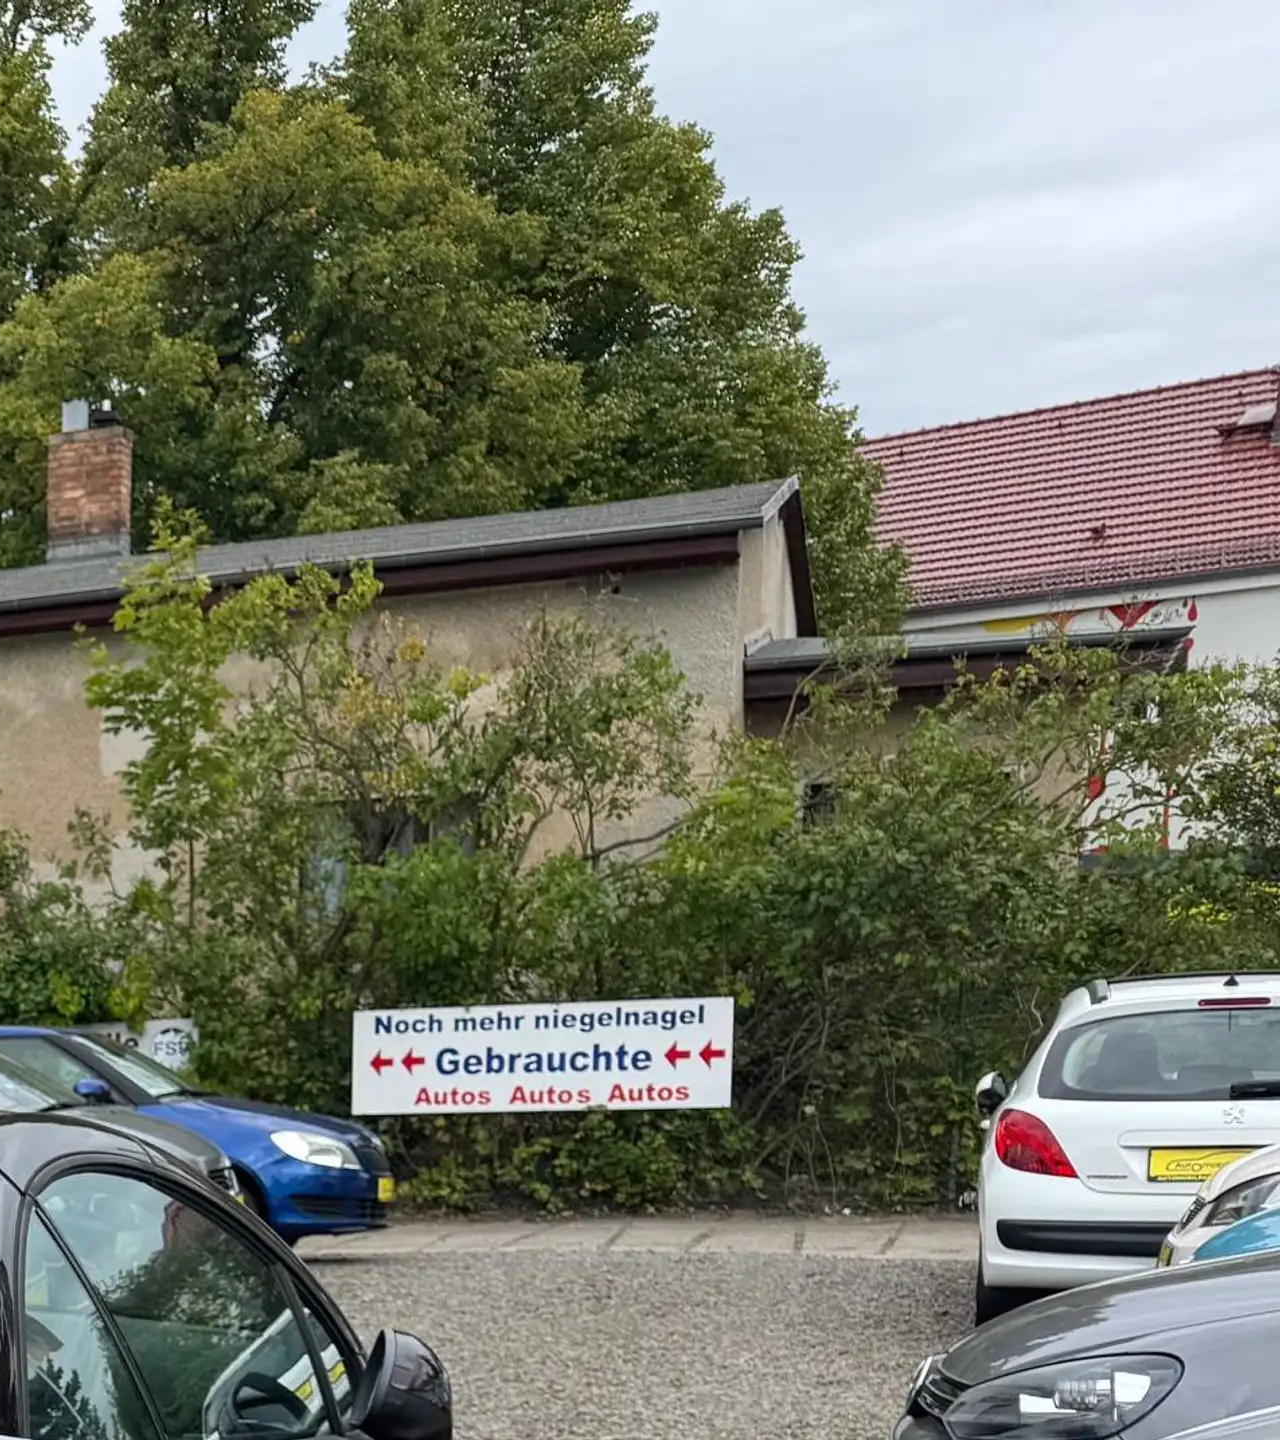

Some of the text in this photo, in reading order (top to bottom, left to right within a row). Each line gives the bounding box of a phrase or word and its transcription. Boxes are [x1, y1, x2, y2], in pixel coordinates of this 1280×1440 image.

[373, 1003, 707, 1035] Noch mehr niegelnagel
[435, 1043, 653, 1076] Gebrauchte
[414, 1082, 690, 1106] Autos Autos Autos
